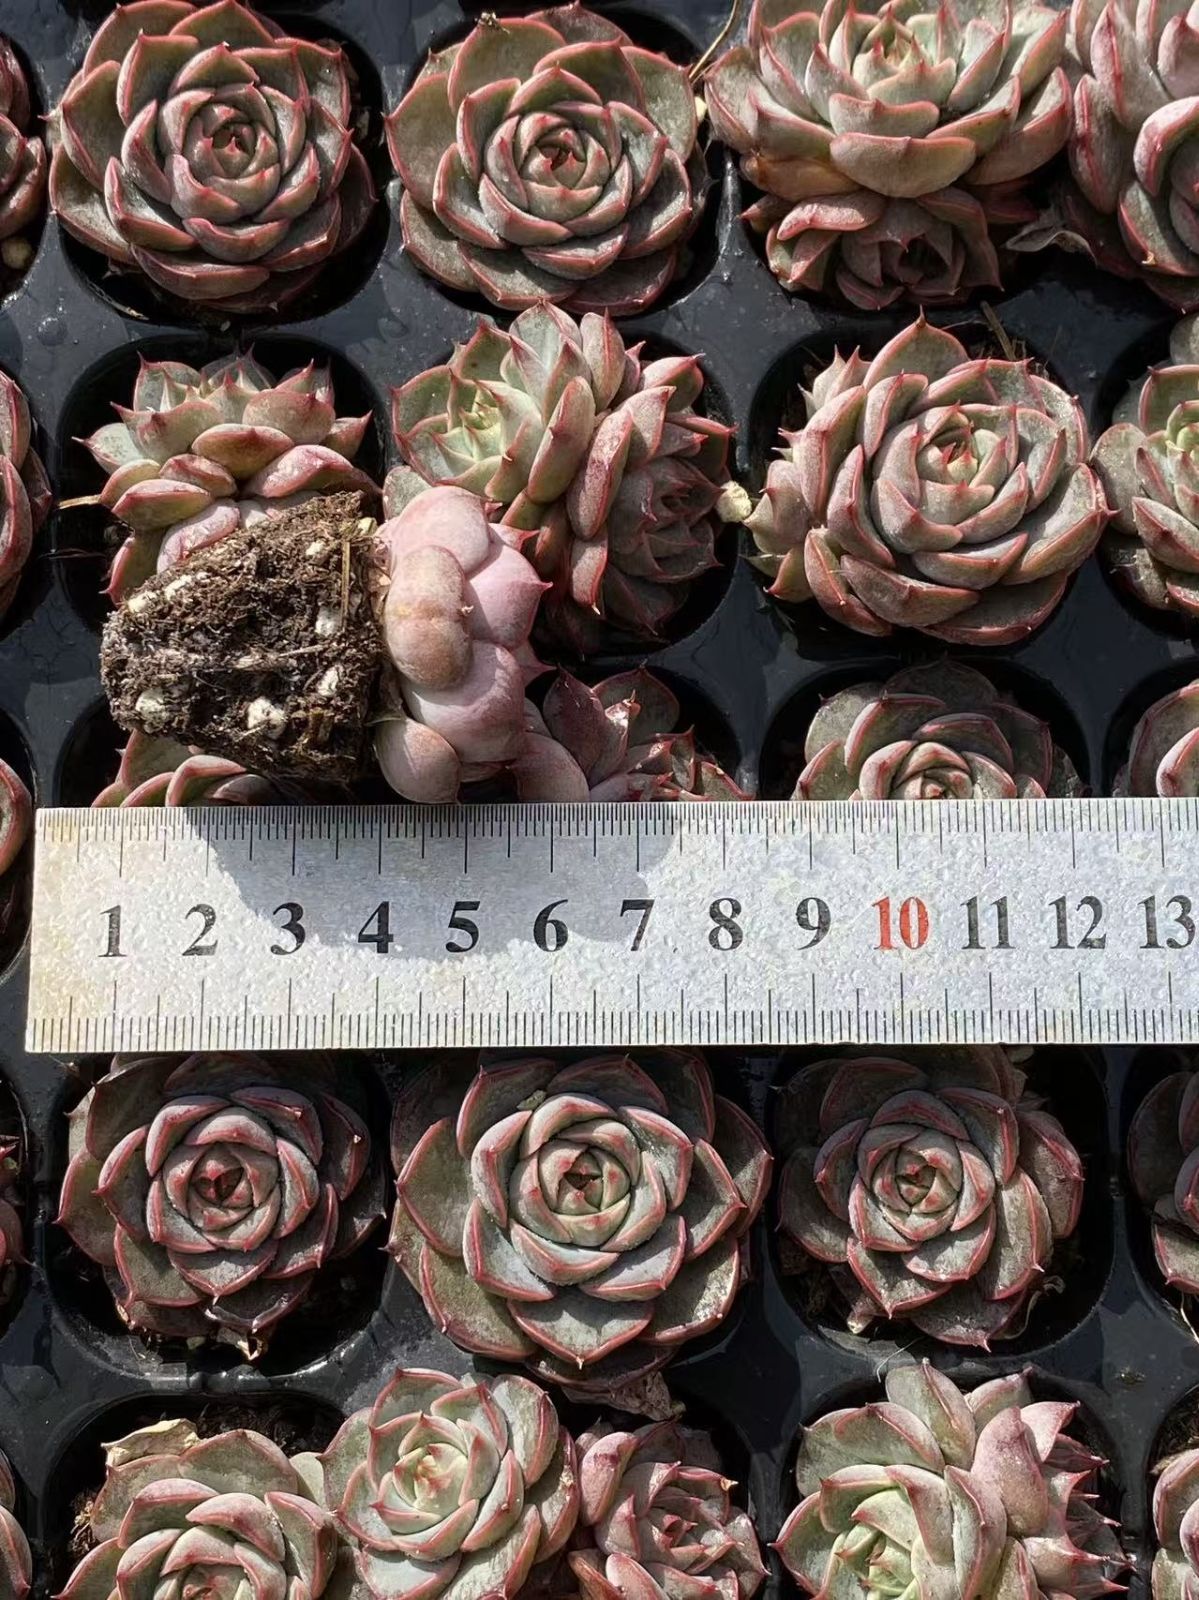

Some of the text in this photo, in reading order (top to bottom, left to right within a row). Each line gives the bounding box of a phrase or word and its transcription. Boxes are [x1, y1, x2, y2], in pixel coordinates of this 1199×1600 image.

[98, 895, 1196, 957] 1 2 3 4 5 6 7 8 9 10 11 12 13
